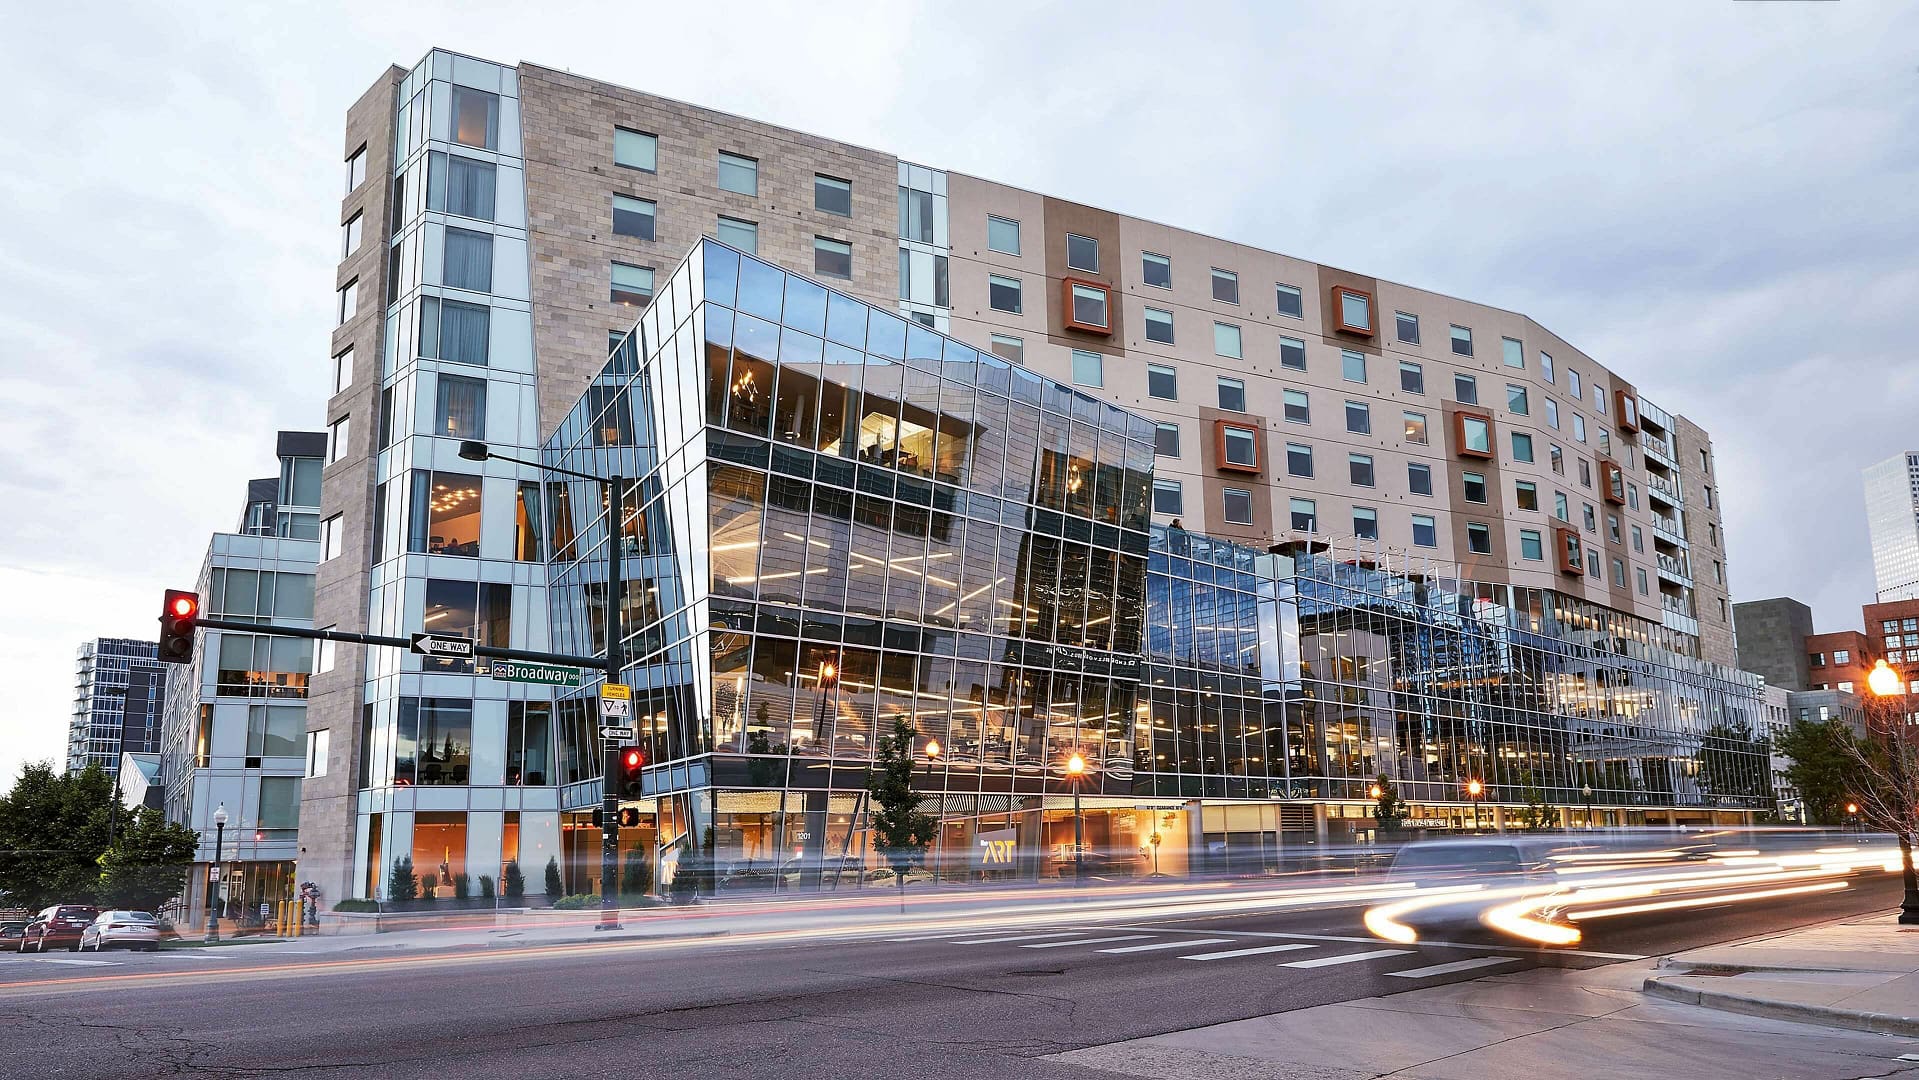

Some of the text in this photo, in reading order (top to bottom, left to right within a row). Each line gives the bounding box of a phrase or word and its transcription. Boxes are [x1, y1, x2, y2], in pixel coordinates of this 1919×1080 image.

[431, 641, 468, 652] ONE WAY
[507, 664, 568, 684] Broadway
[982, 840, 1017, 864] ART
